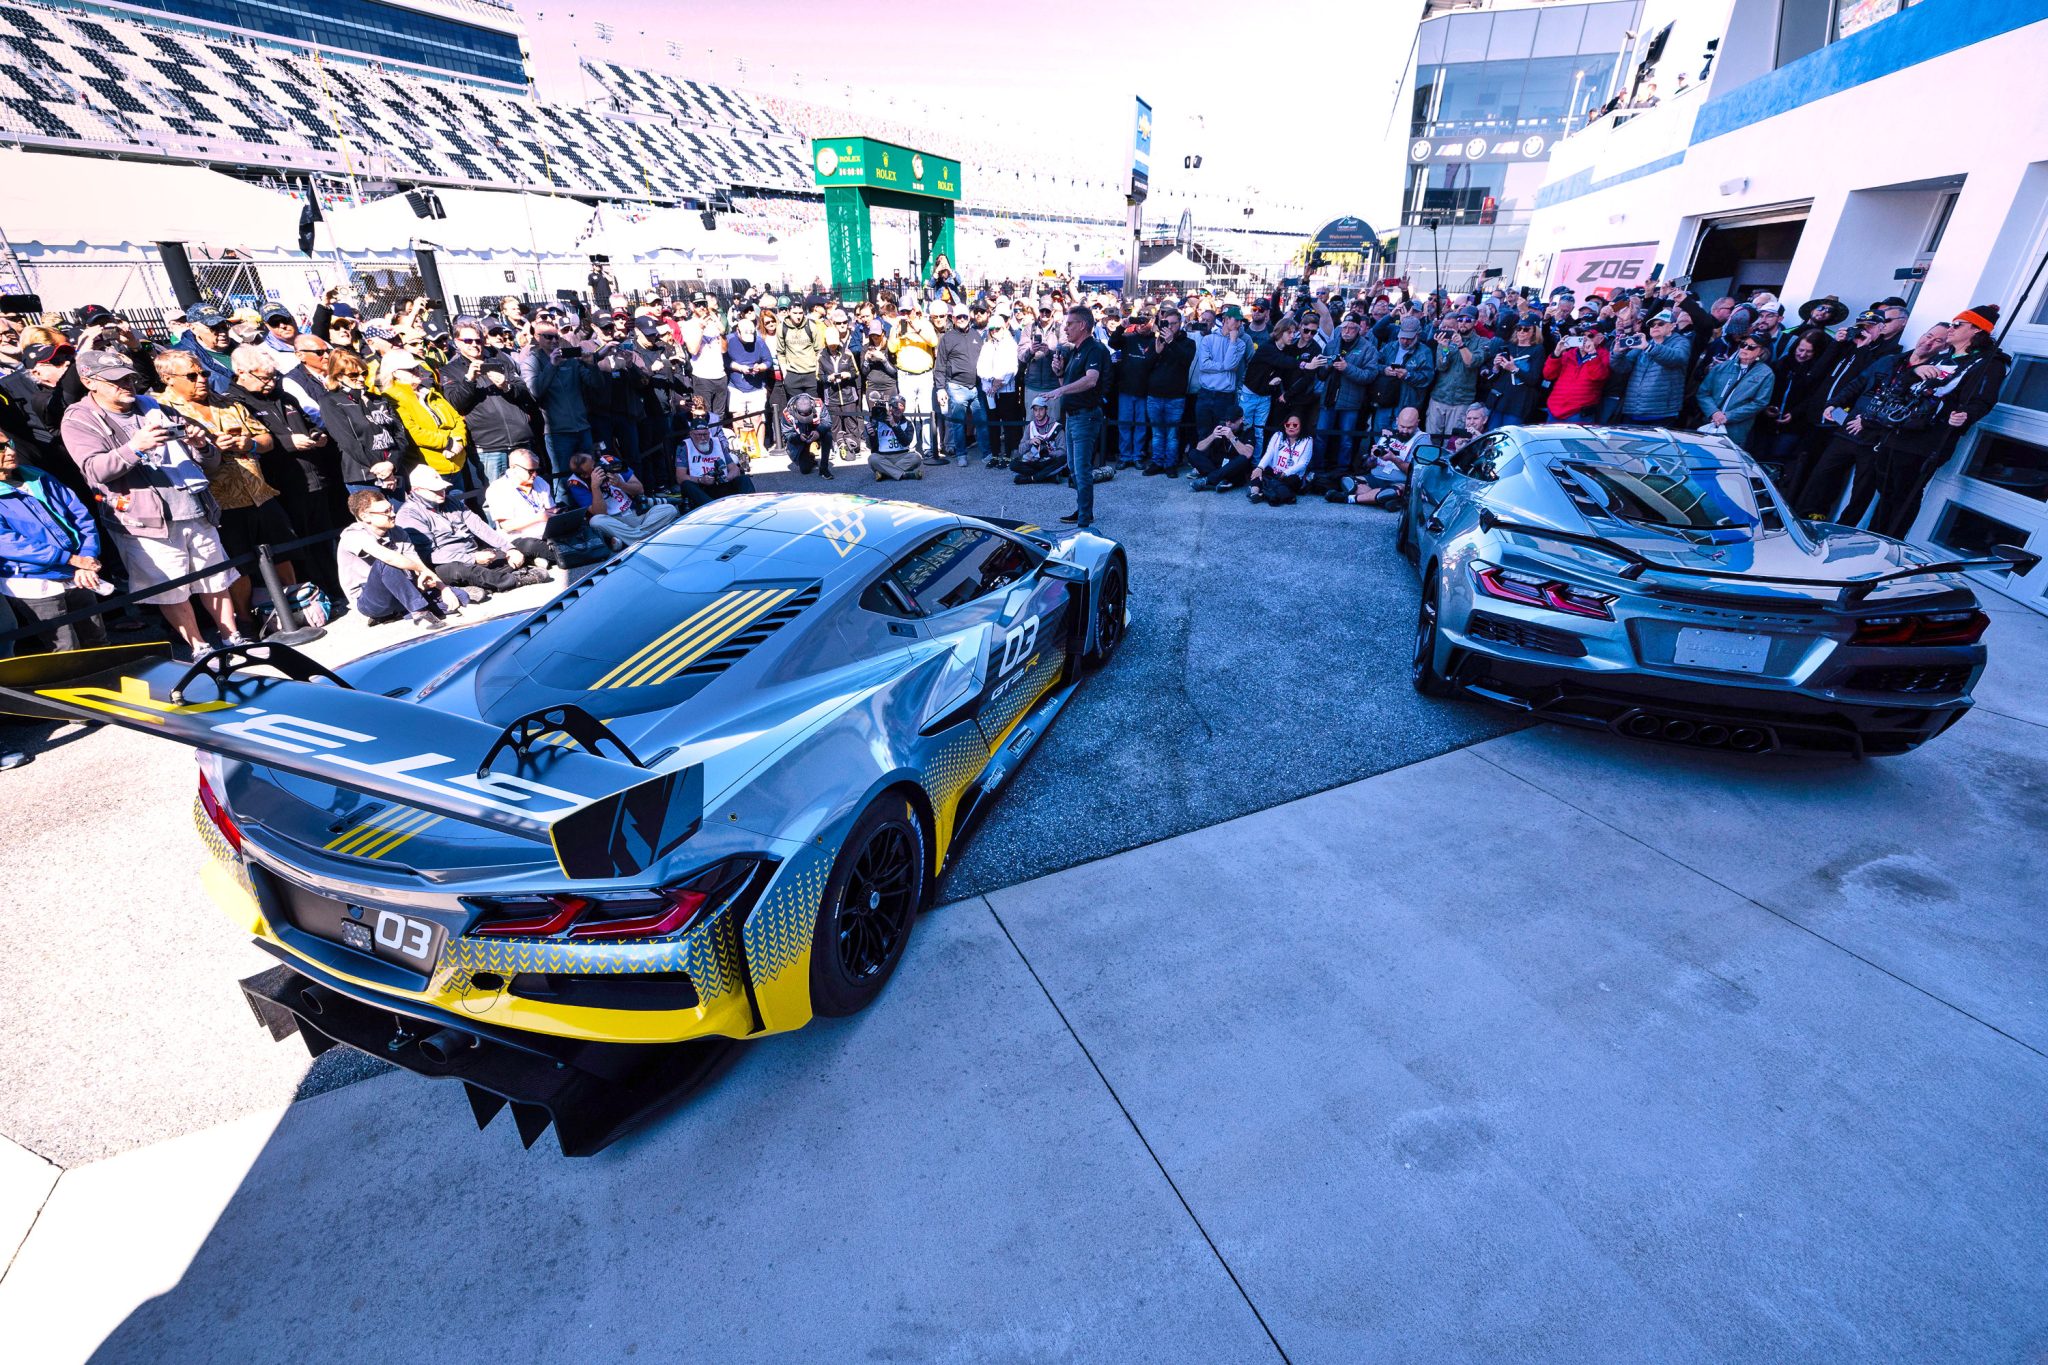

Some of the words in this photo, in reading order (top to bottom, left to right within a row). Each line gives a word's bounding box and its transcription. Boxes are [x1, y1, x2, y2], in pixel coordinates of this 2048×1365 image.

[876, 168, 896, 181] ROLEX
[937, 180, 954, 192] ROLEX
[1576, 260, 1644, 283] Z06
[1658, 604, 1815, 625] CORVETTE
[998, 614, 1040, 678] 03
[375, 910, 432, 960] 03
